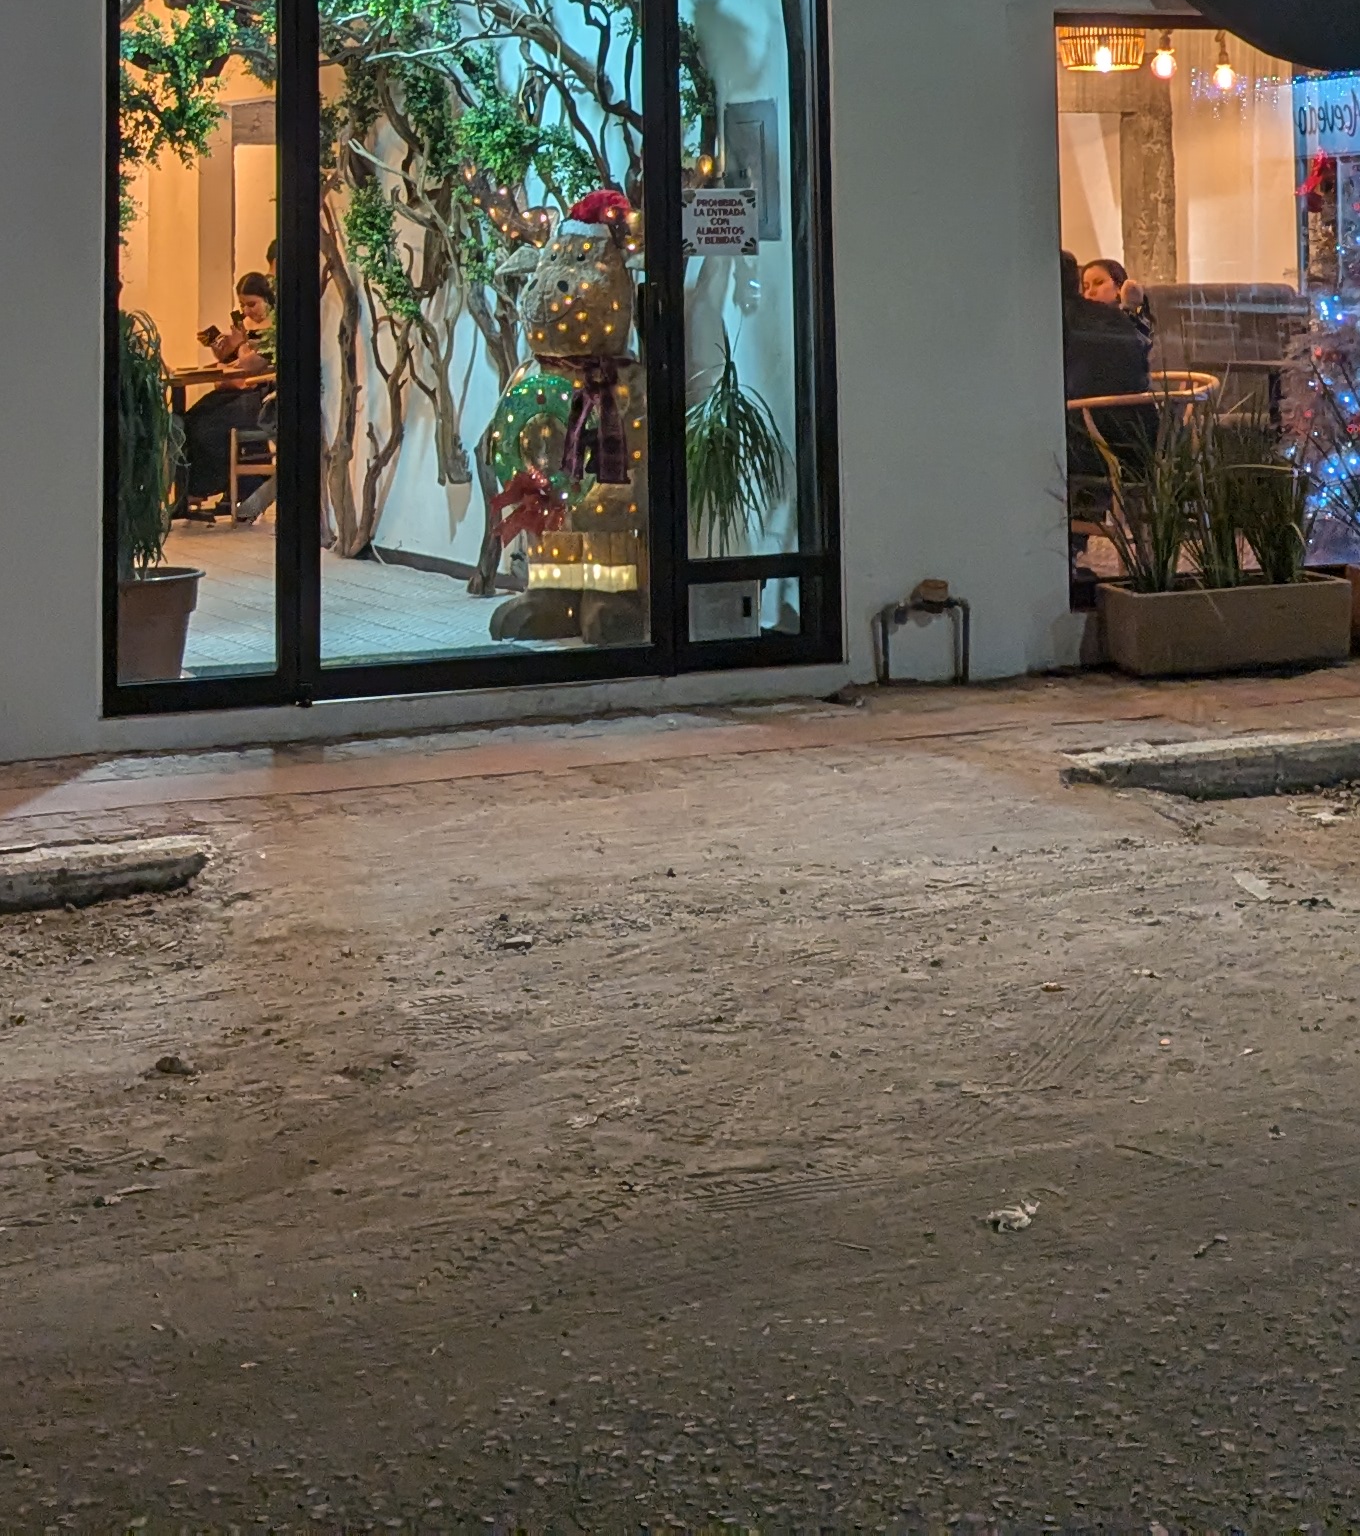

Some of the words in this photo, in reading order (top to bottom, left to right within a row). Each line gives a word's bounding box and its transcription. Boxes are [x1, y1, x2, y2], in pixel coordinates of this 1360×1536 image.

[696, 198, 743, 207] PROHIBIDA
[693, 208, 705, 216] LA
[706, 208, 746, 216] ENTRADA
[709, 217, 730, 226] CON
[696, 226, 745, 235] ALIMENTOS
[697, 236, 703, 244] Y
[704, 236, 742, 244] BEBIDAS
